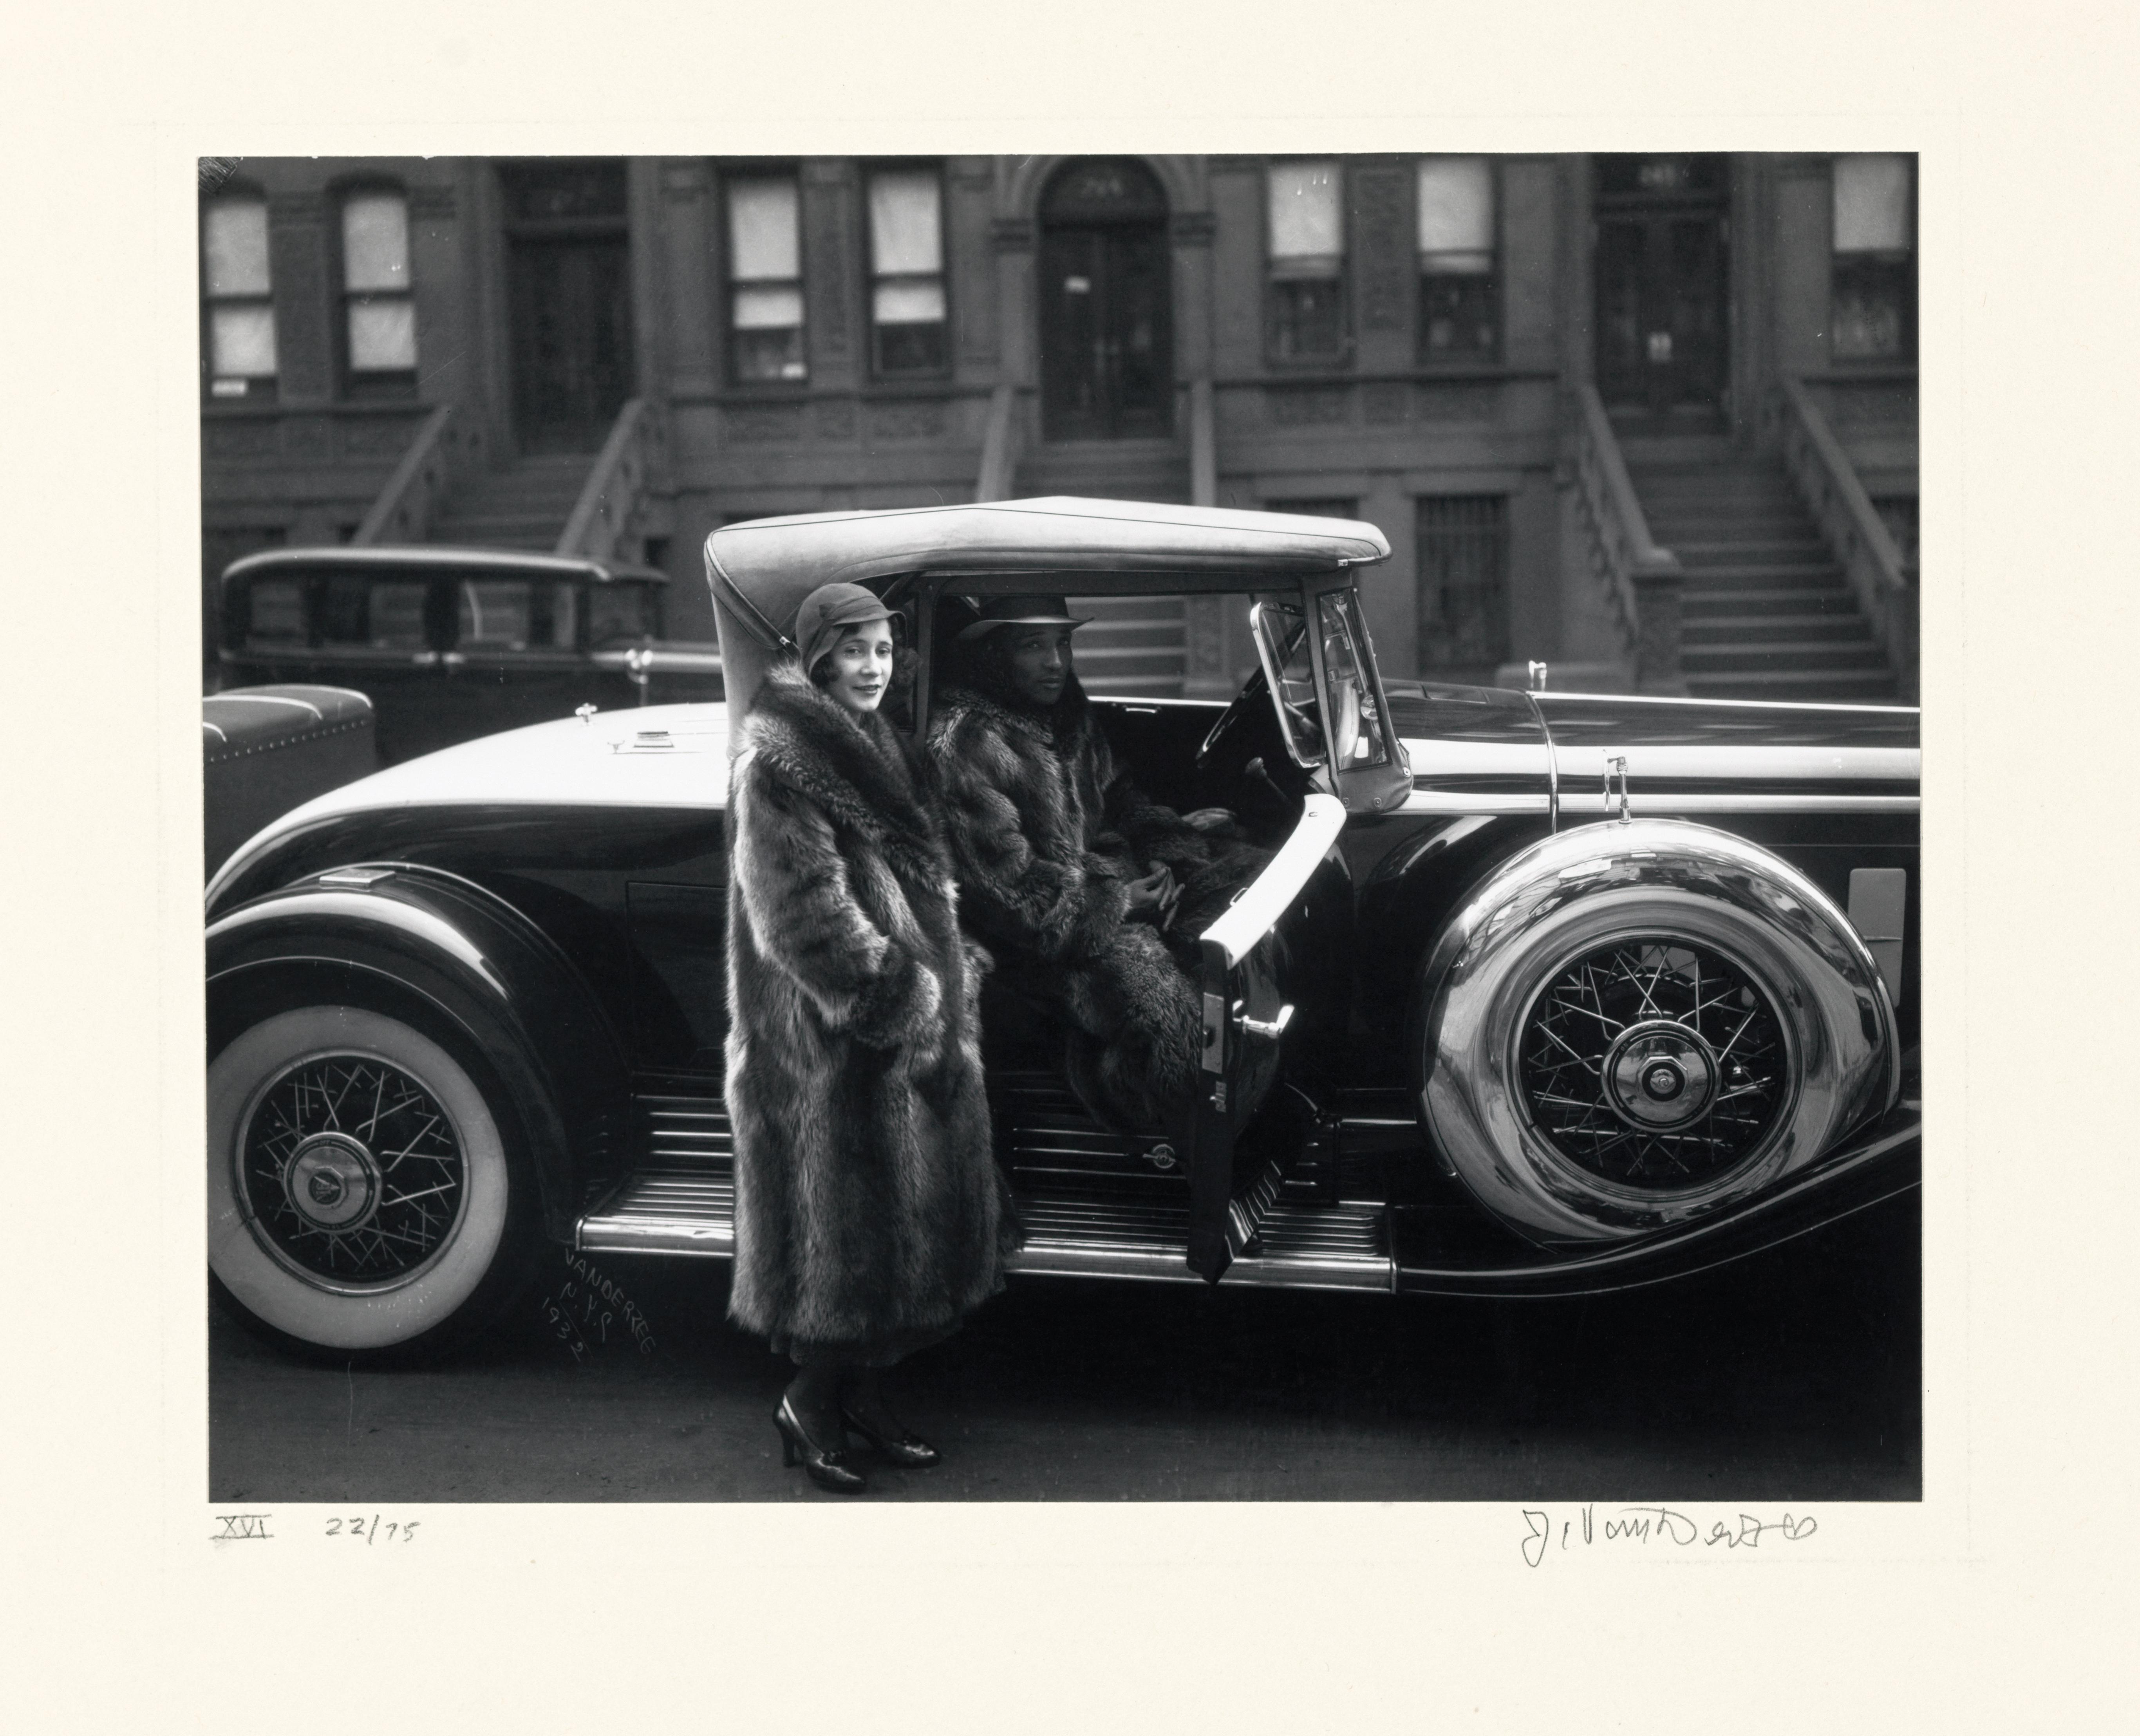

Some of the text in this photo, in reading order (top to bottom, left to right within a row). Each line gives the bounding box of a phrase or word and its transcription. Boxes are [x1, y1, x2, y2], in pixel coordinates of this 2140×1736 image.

[542, 1297, 583, 1362] 1932
[208, 1514, 274, 1540] XVI
[325, 1514, 421, 1545] 22/75
